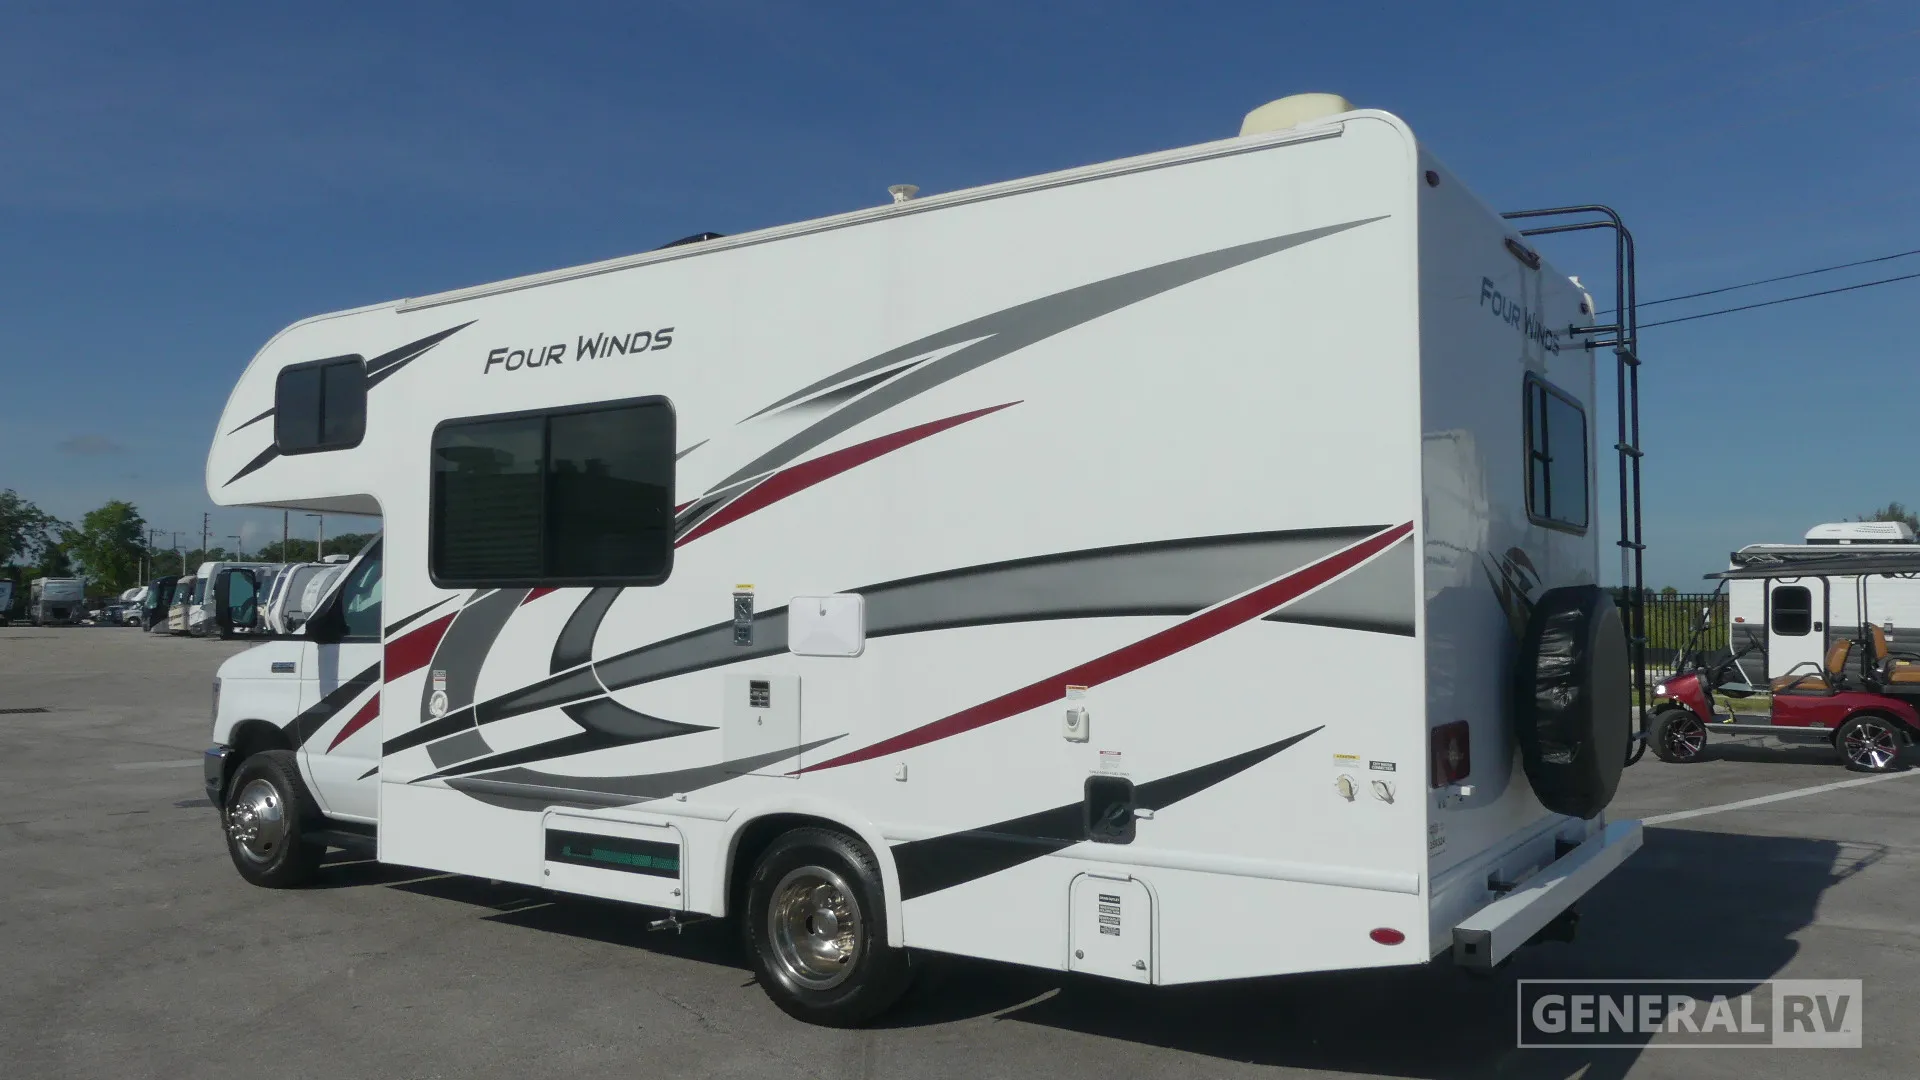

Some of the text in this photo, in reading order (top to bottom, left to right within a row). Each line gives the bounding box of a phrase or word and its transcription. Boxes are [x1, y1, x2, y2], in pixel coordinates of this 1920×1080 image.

[1480, 276, 1521, 330] FOUR
[483, 326, 675, 375] FOUR WINDS
